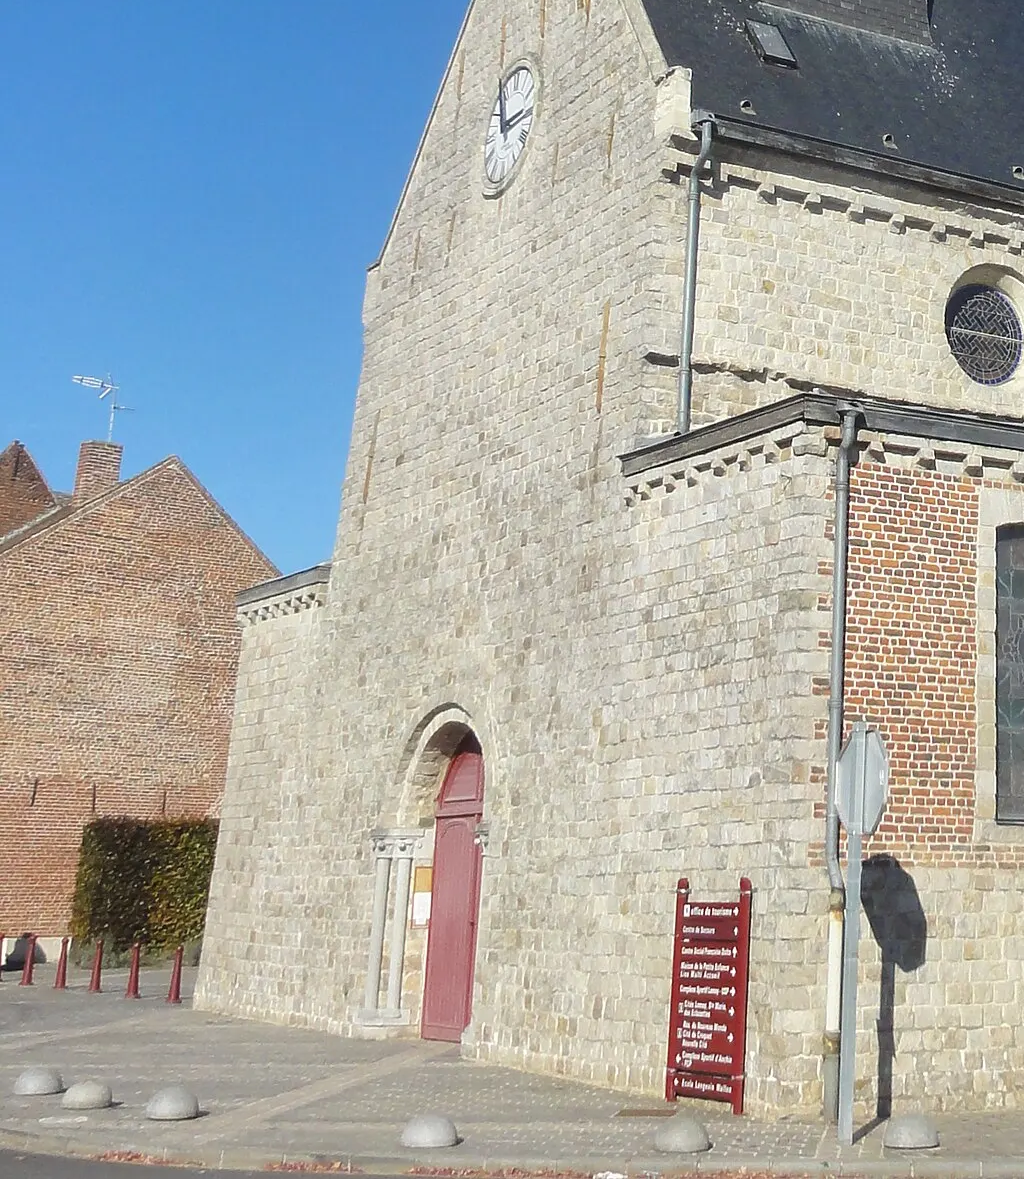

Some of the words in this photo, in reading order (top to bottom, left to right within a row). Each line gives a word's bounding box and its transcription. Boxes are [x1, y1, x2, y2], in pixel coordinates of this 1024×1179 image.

[691, 907, 703, 916] office
[712, 907, 731, 917] tourisme
[683, 925, 694, 934] Centre
[682, 946, 693, 955] Centre
